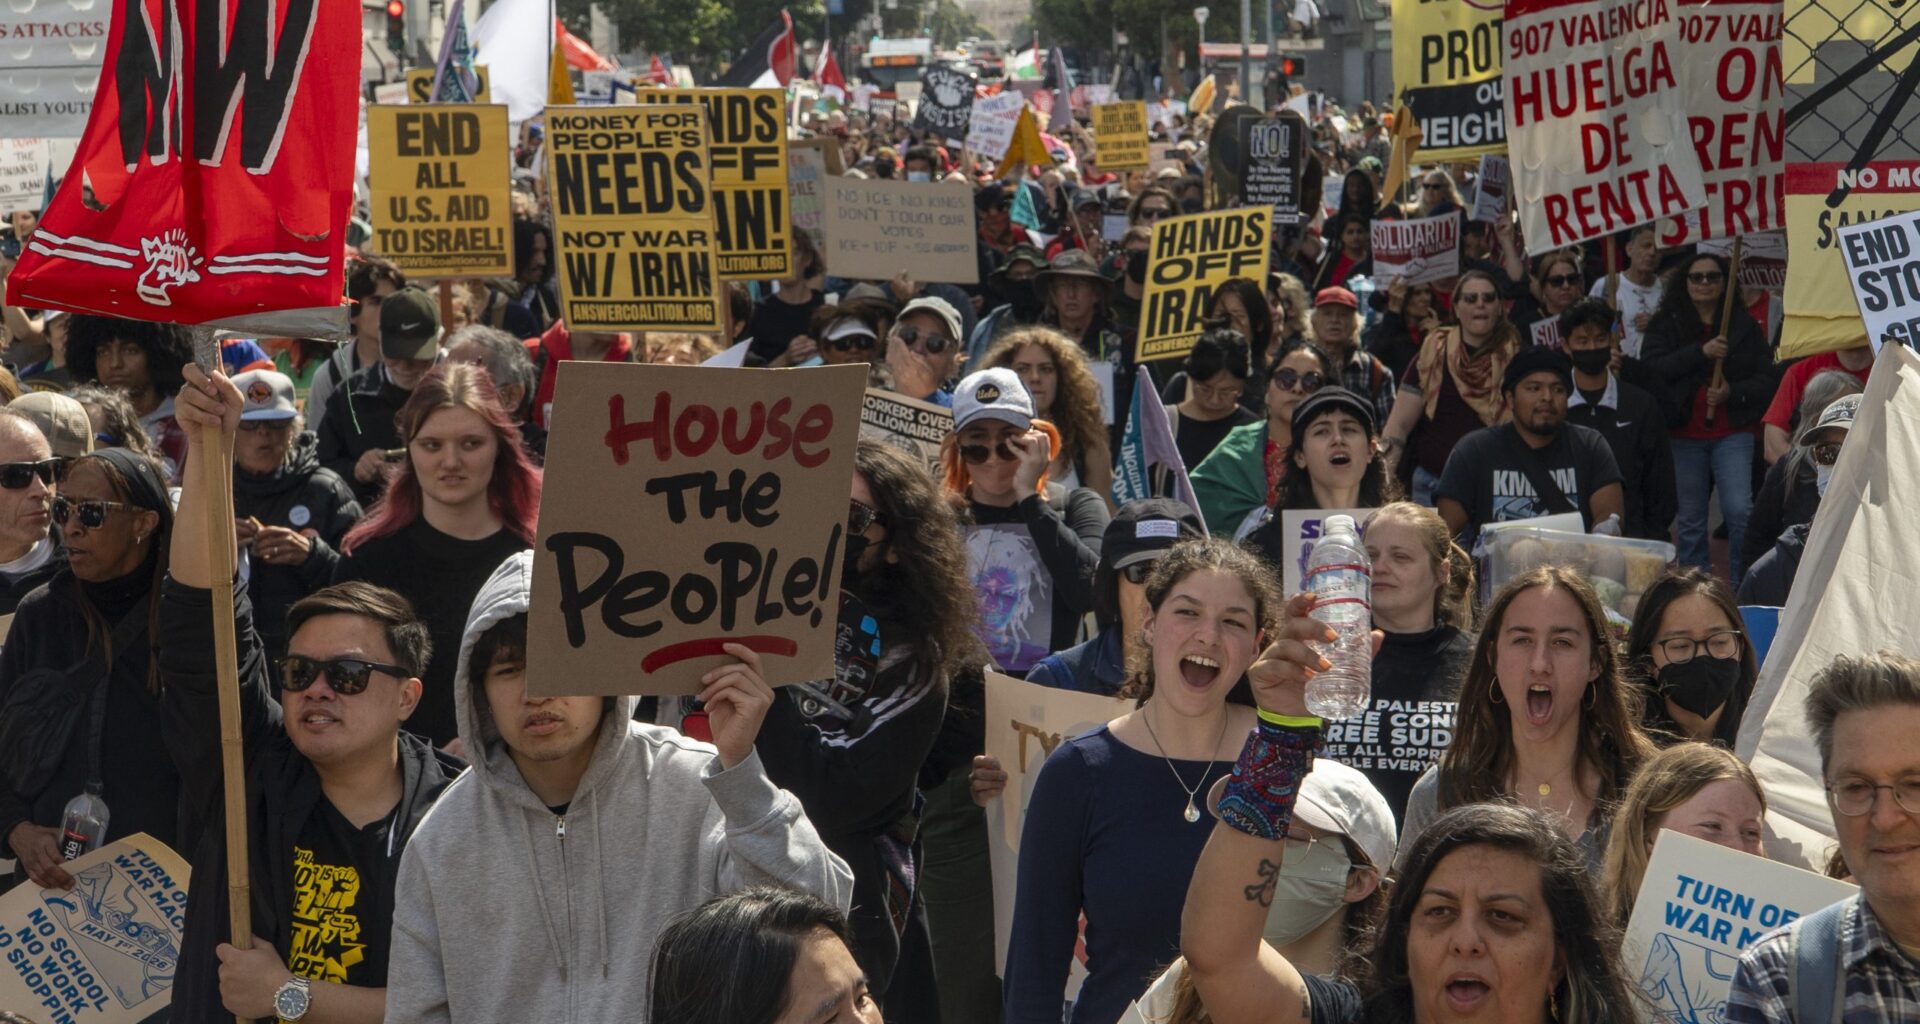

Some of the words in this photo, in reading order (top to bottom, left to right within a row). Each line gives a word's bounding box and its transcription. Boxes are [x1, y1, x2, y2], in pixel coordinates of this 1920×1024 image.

[13, 22, 104, 37] ATTACKS
[1509, 20, 1555, 60] 907
[1559, 0, 1670, 48] VALENCIA
[927, 71, 974, 97] FUCK
[1512, 41, 1677, 128] HUELGA
[396, 112, 480, 157] END
[551, 115, 643, 130] MONEY
[647, 113, 699, 128] FOR
[553, 130, 701, 150] PEOPLE'S
[1250, 124, 1290, 158] NO!
[1581, 113, 1633, 175] DE
[416, 162, 465, 189] ALL
[554, 150, 706, 216] NEEDS
[1259, 184, 1291, 194] REFUSE
[1837, 167, 1878, 190] NO
[390, 196, 440, 223] U.S.
[446, 195, 489, 222] AID
[836, 189, 858, 202] NO
[866, 192, 890, 205] ICE
[901, 195, 923, 208] NO
[928, 196, 967, 209] KINGS
[1543, 163, 1690, 247] RENTA
[838, 207, 880, 221] DON'T
[887, 210, 934, 225] TOUCH
[939, 214, 967, 226] OUR
[880, 225, 925, 238] VOTES
[1371, 218, 1457, 249] SOLIDARITY
[378, 228, 408, 253] TO
[414, 227, 504, 253] ISRAEL!
[562, 231, 625, 248] NOT
[632, 230, 708, 247] WAR
[1156, 212, 1266, 260] HANDS
[1844, 224, 1911, 269] END
[564, 252, 616, 297] W/
[629, 251, 712, 297] IRAN
[1153, 249, 1263, 285] OFF
[572, 301, 713, 323] ANSWERCOALITION.ORG
[861, 408, 946, 441] BILLIONAIRES
[864, 396, 915, 421] ORKERS
[918, 412, 955, 431] OVER
[1353, 745, 1386, 756] ALL
[130, 849, 177, 889] TURN
[114, 854, 154, 891] WAR
[150, 890, 186, 934] MAC
[1677, 874, 1755, 920] TURN
[1665, 901, 1733, 945] WAR
[27, 907, 56, 936] NO
[51, 937, 110, 1012] SCHOOL
[80, 923, 115, 946] MAY
[132, 949, 168, 969] 2026
[16, 926, 44, 956] NO
[39, 955, 89, 1015] WORK
